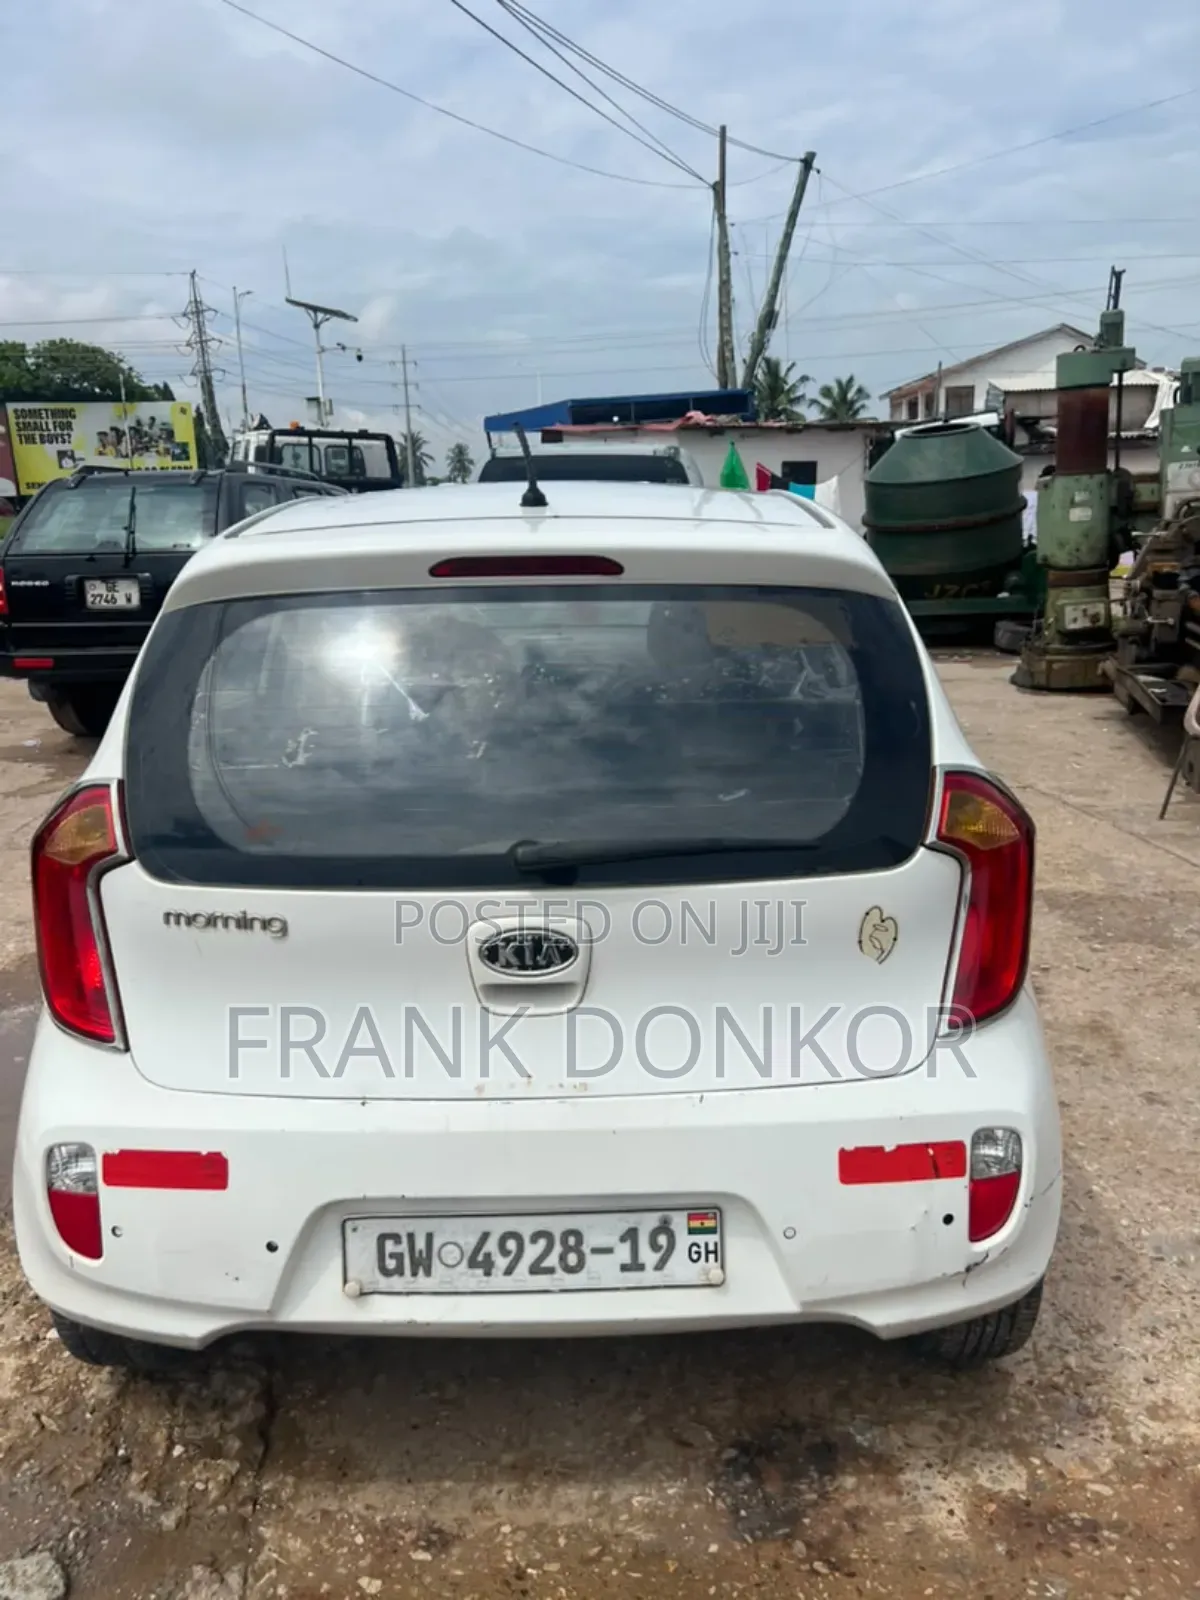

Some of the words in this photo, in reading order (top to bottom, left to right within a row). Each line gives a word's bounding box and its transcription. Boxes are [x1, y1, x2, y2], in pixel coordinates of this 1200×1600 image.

[13, 408, 76, 419] SOMETHING
[15, 421, 50, 431] SMALL
[53, 421, 73, 431] FOR
[17, 433, 37, 444] THE
[39, 433, 71, 443] BOYS?
[163, 911, 288, 940] morning
[497, 942, 562, 966] KIA
[376, 1232, 434, 1277] GW
[467, 1226, 676, 1276] 4928-19
[688, 1242, 719, 1263] GH
